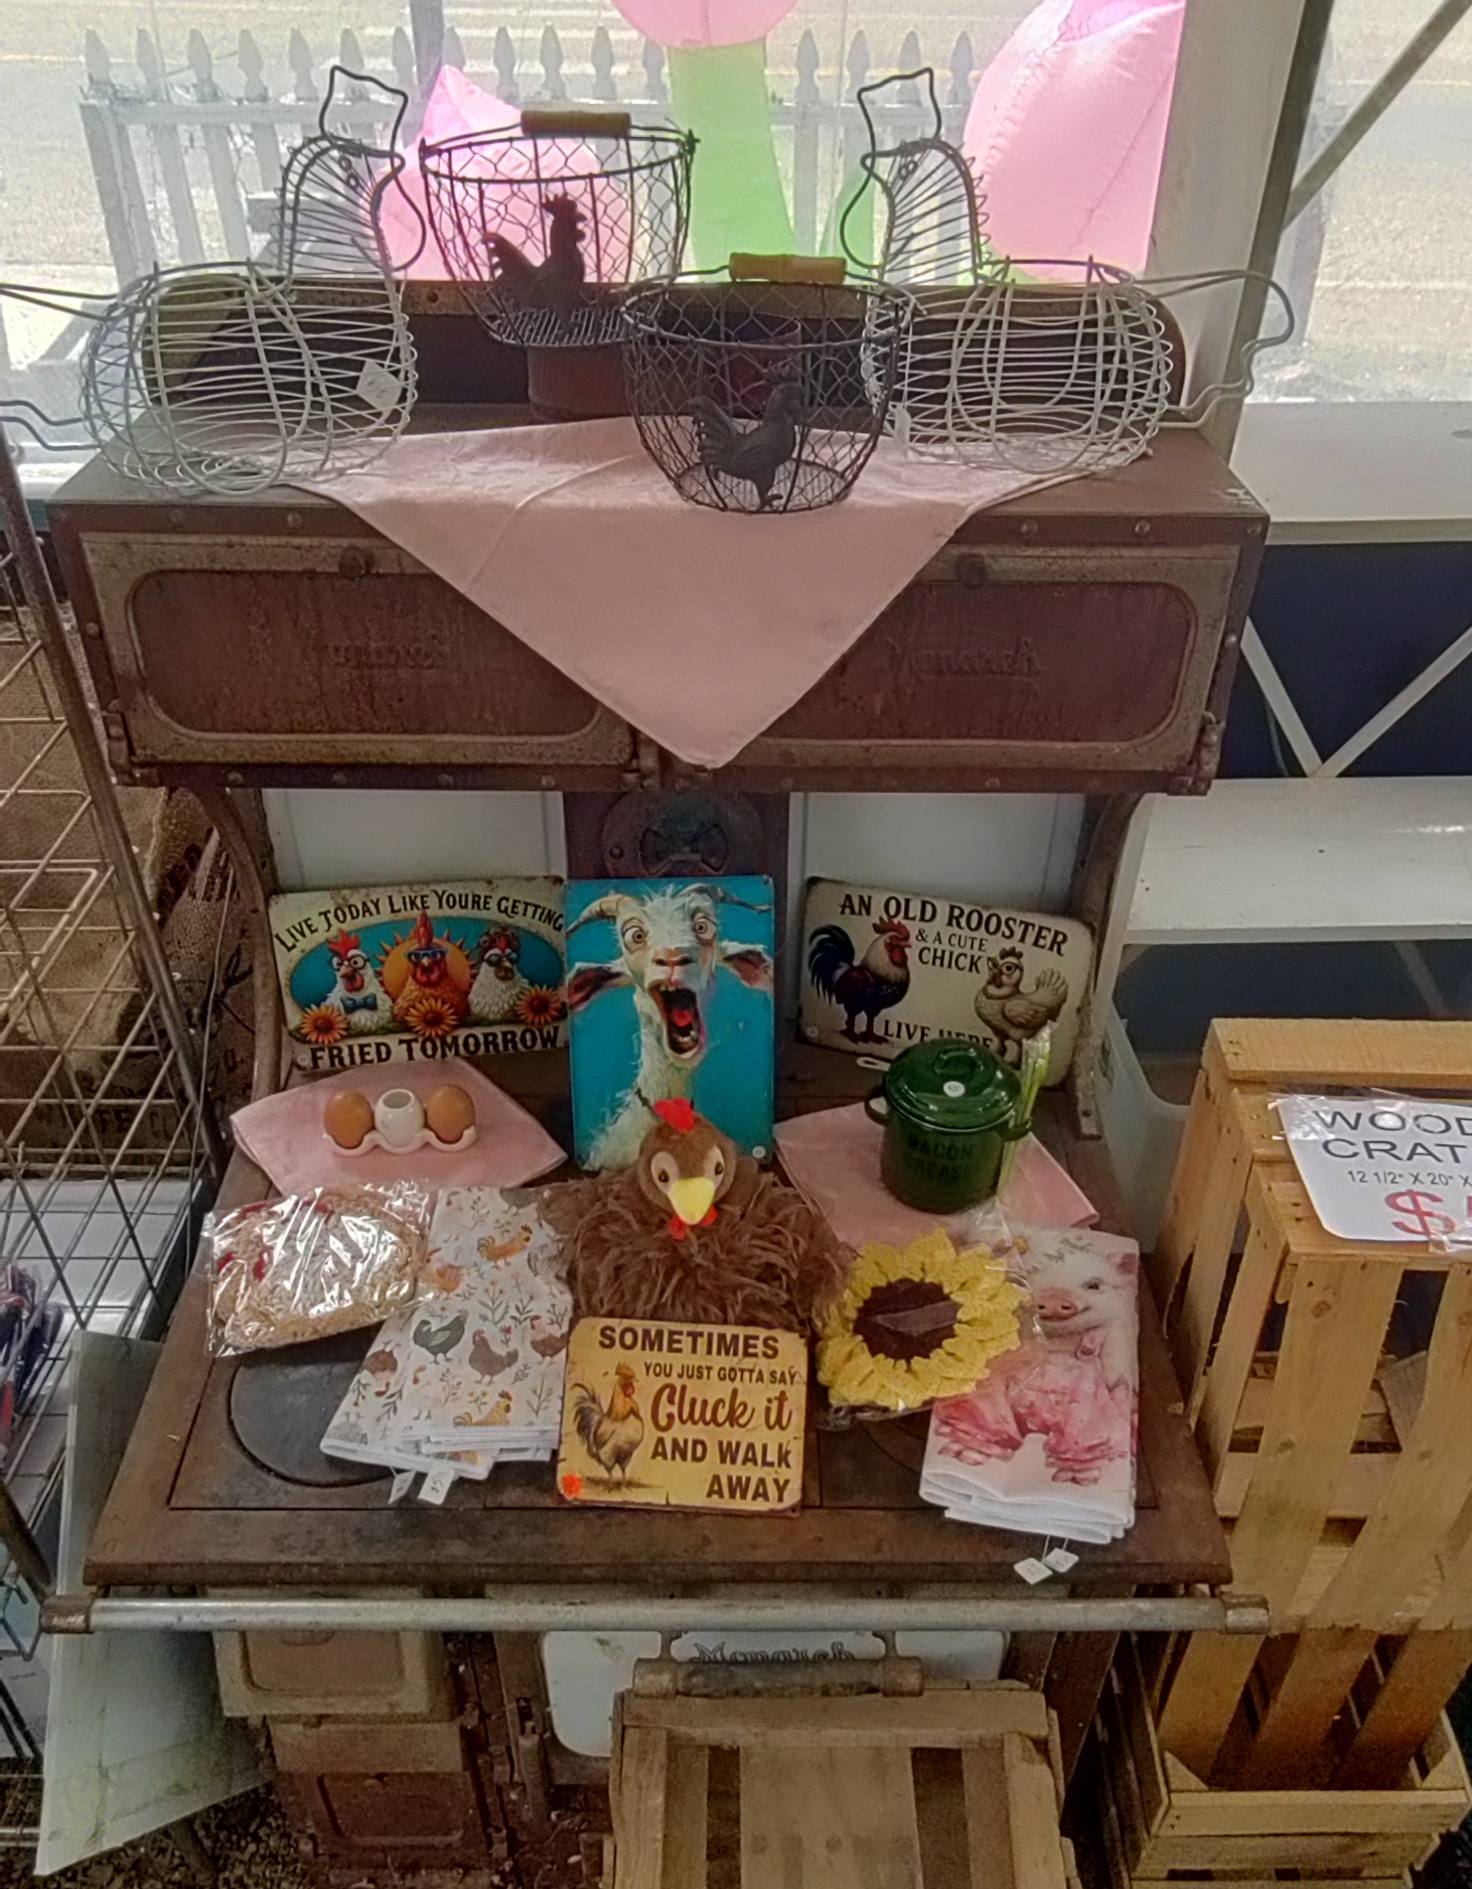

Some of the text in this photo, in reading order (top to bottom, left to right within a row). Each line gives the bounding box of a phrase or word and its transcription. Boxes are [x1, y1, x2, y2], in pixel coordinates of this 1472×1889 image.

[274, 917, 318, 953] LIVE
[318, 897, 381, 933] TODAY
[387, 894, 430, 914] LIKE
[496, 896, 564, 932] GETTING
[840, 894, 1069, 956] AN OLD ROOSTER
[915, 928, 988, 953] & A CUTE
[918, 946, 982, 974] CHICK
[883, 1019, 931, 1042] LIVE
[309, 1026, 560, 1070] FRIED TOMORROW
[1347, 1170, 1368, 1183] 12
[1408, 1172, 1425, 1185] X
[599, 1325, 779, 1359] SOMETIMES
[644, 1361, 797, 1385] YOU JUST GOTTA SAY
[651, 1382, 793, 1432] Cluck it
[650, 1436, 792, 1468] AND WALK
[706, 1474, 791, 1502] AWAY
